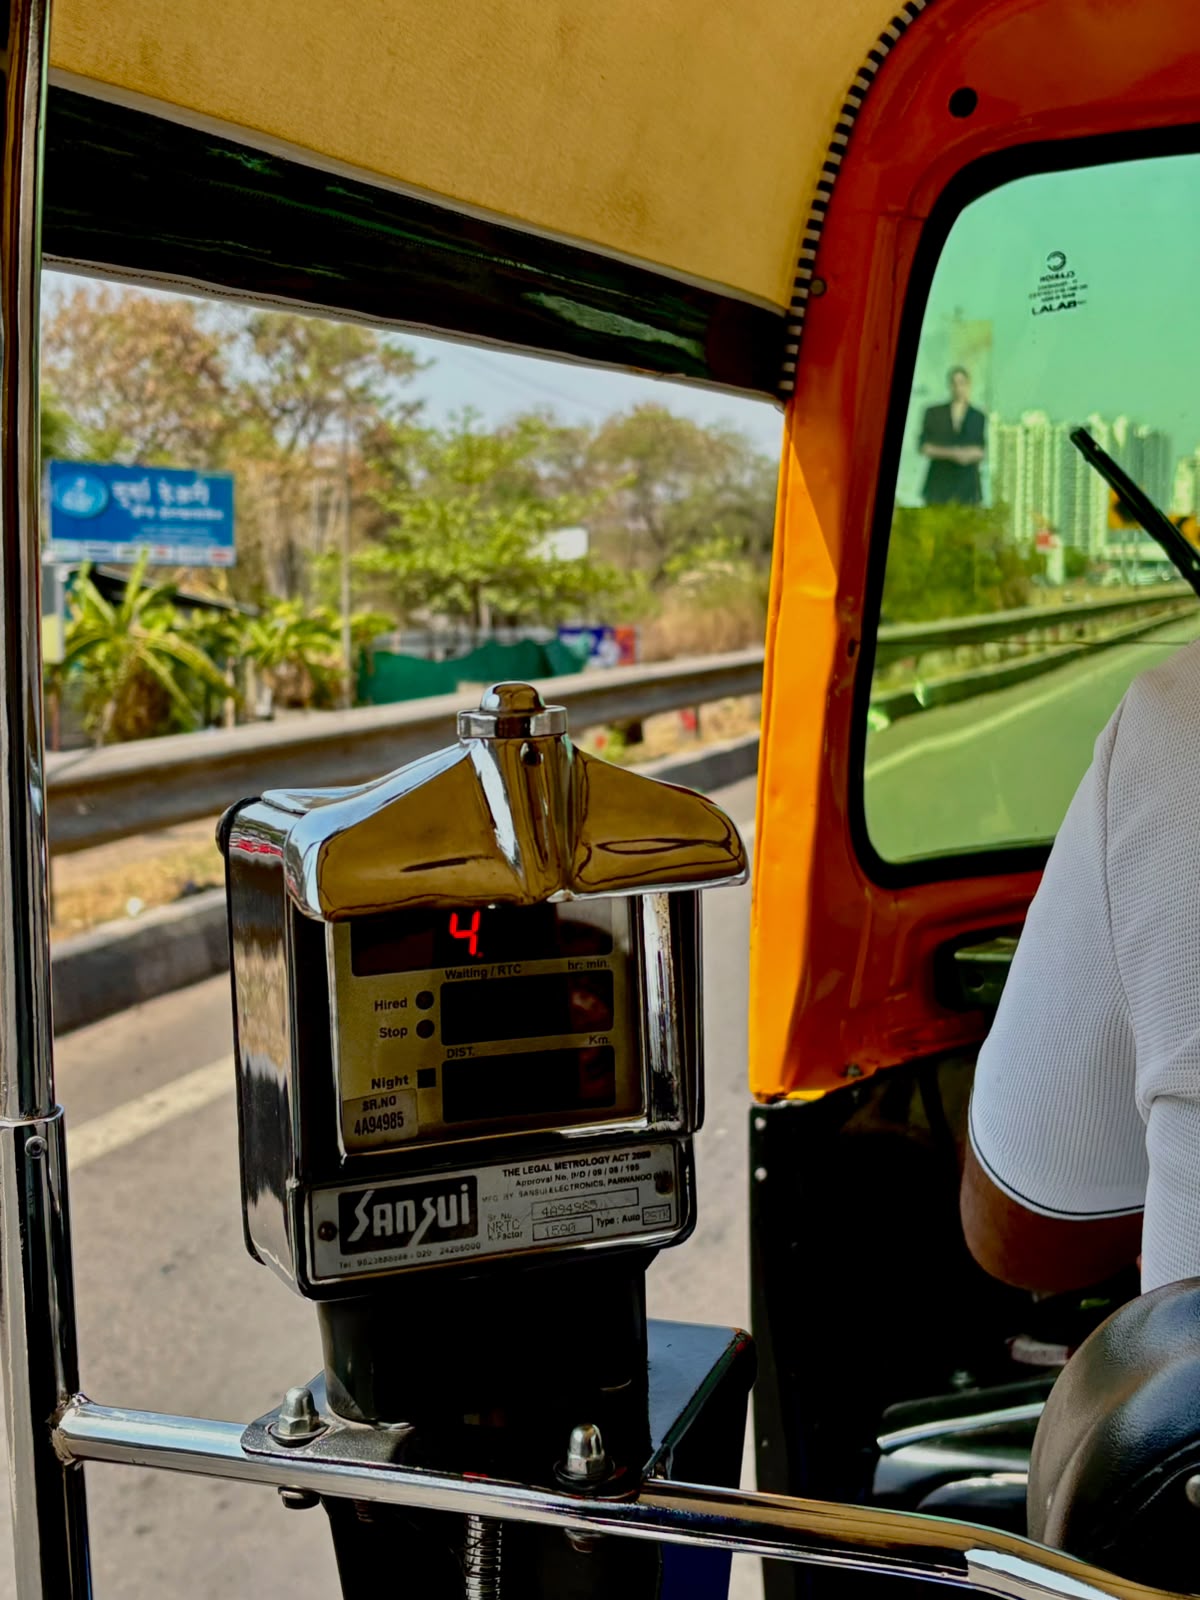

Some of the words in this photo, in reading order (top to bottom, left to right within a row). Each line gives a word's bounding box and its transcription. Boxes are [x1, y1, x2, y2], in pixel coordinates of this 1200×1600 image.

[445, 966, 488, 979] Waiting
[496, 964, 522, 976] RTC
[374, 997, 408, 1012] Hired
[379, 1025, 408, 1039] Stop
[371, 1075, 409, 1090] Night
[354, 1111, 405, 1137] 4A94985
[502, 1168, 520, 1177] THE
[523, 1164, 552, 1175] LEGAL
[555, 1155, 610, 1171] METROLOGY
[612, 1153, 629, 1163] ACT
[516, 1176, 553, 1186] Approval
[596, 1217, 615, 1227] Type
[622, 1213, 640, 1223] Auto
